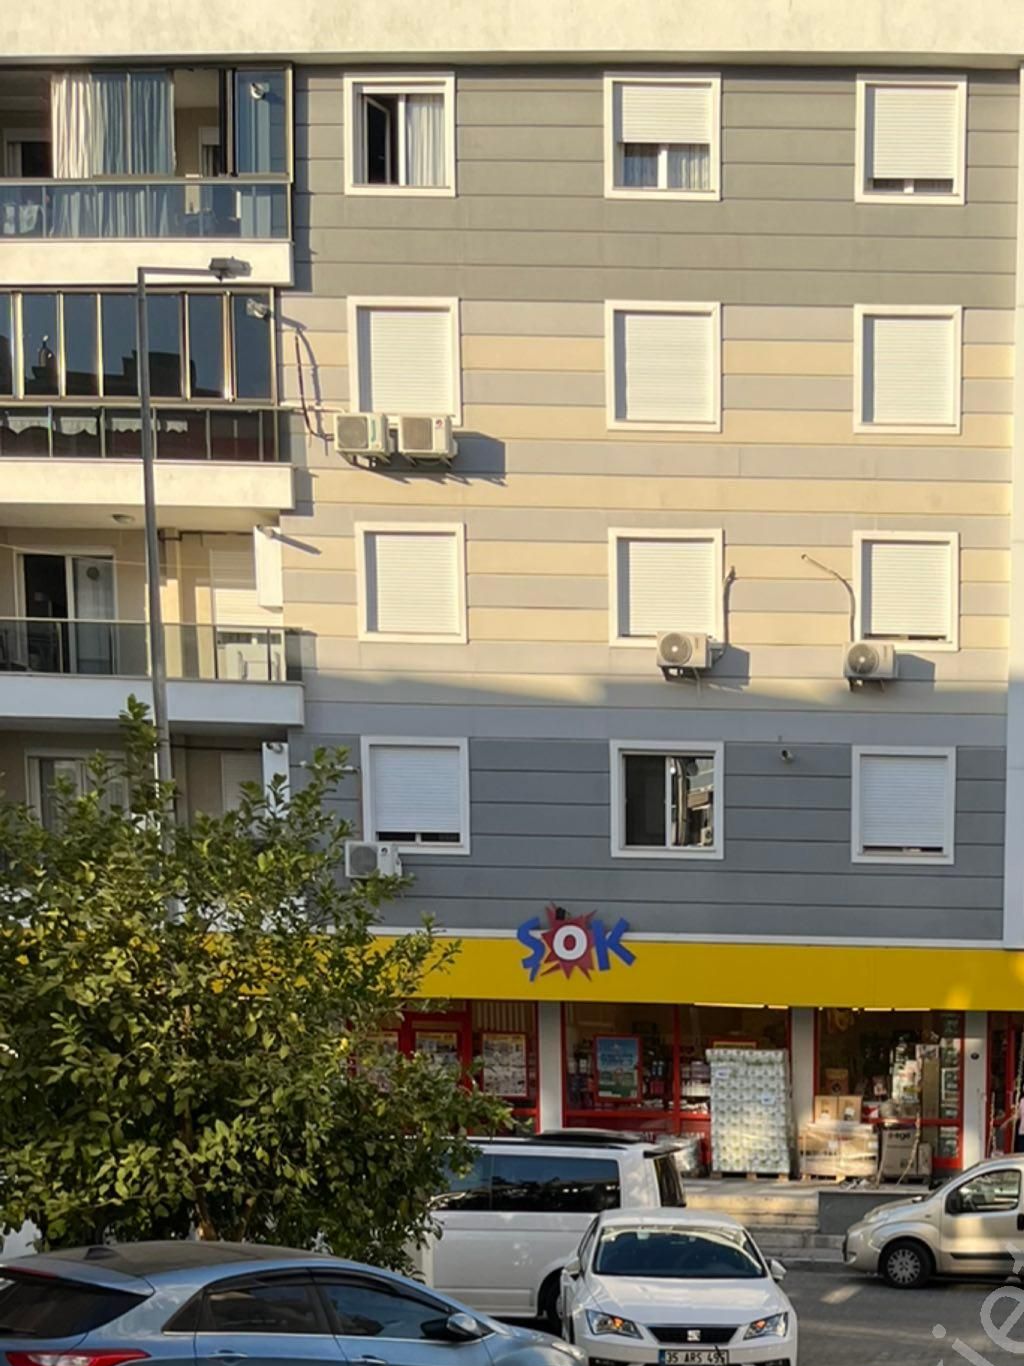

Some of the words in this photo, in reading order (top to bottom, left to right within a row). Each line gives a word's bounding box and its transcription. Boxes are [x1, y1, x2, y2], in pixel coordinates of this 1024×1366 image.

[517, 915, 637, 982] ŞOK
[666, 1352, 679, 1363] 35
[684, 1352, 703, 1363] ARS
